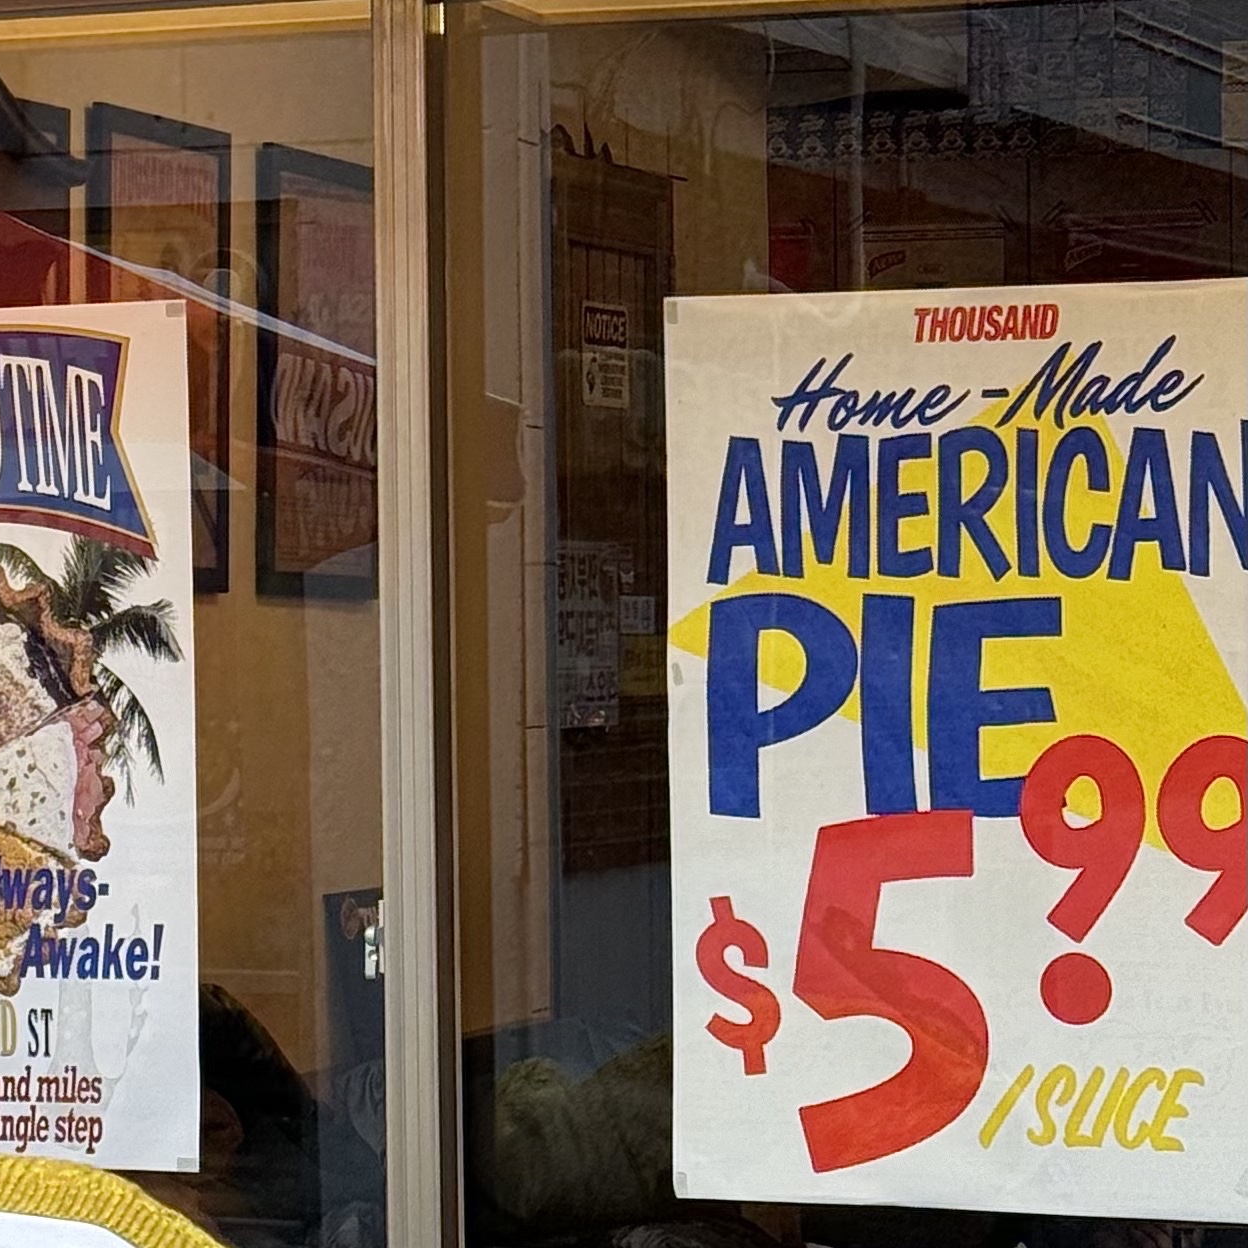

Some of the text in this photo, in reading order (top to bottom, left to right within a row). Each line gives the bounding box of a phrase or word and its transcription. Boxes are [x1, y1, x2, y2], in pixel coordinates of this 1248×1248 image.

[585, 311, 626, 342] NOTICE
[914, 303, 1059, 343] THOUSAND
[706, 419, 1248, 585] AMERICAN
[708, 592, 1062, 818] PIE
[19, 923, 164, 981] Awake!
[26, 1006, 54, 1058] ST
[37, 1067, 103, 1104] miles
[54, 1111, 103, 1155] step
